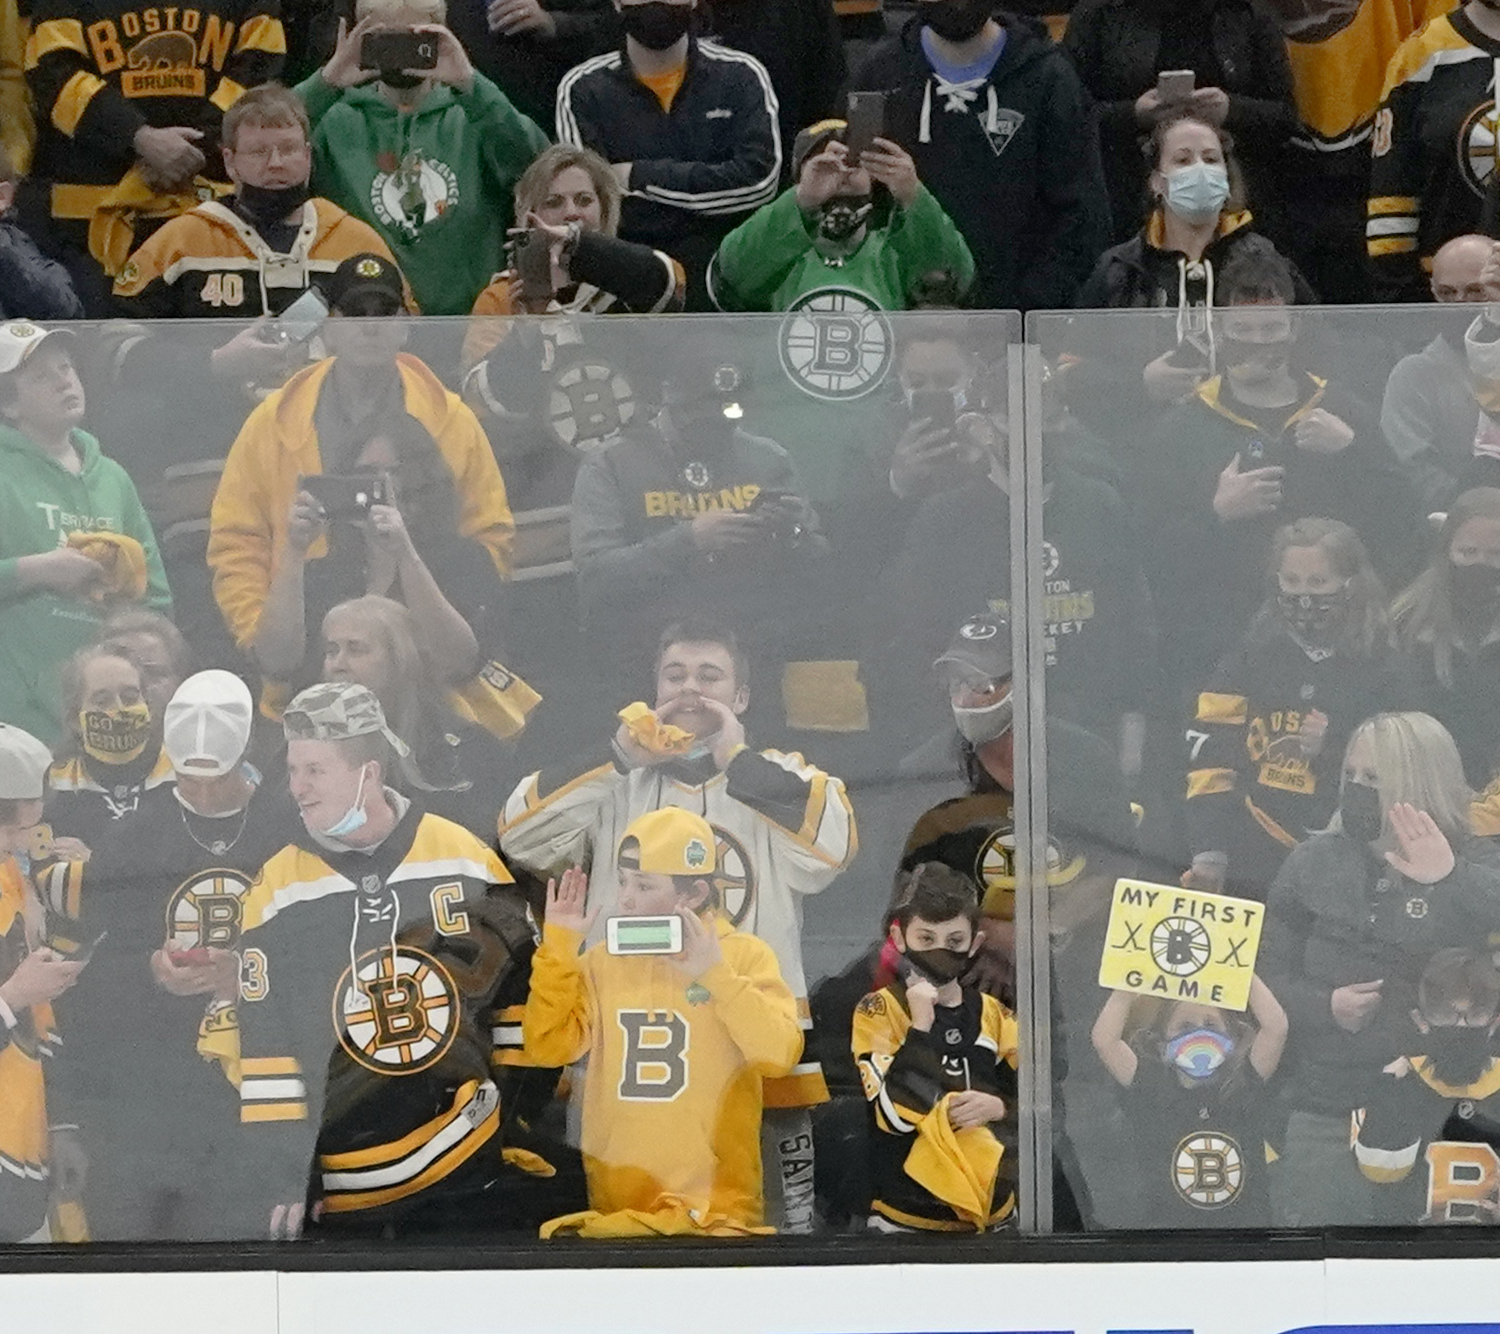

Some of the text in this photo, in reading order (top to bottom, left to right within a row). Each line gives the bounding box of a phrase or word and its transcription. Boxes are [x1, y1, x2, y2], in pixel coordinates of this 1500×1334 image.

[88, 9, 232, 71] BOSTON
[131, 72, 195, 91] BRUINS
[200, 273, 243, 307] 40
[814, 317, 863, 374] B
[88, 712, 112, 730] GO
[1186, 730, 1208, 761] 7
[431, 883, 470, 937] C
[1120, 886, 1256, 928] MY FIRST
[241, 947, 269, 1001] 3
[1125, 969, 1224, 1003] GAME
[367, 974, 429, 1046] B
[617, 1008, 690, 1101] B
